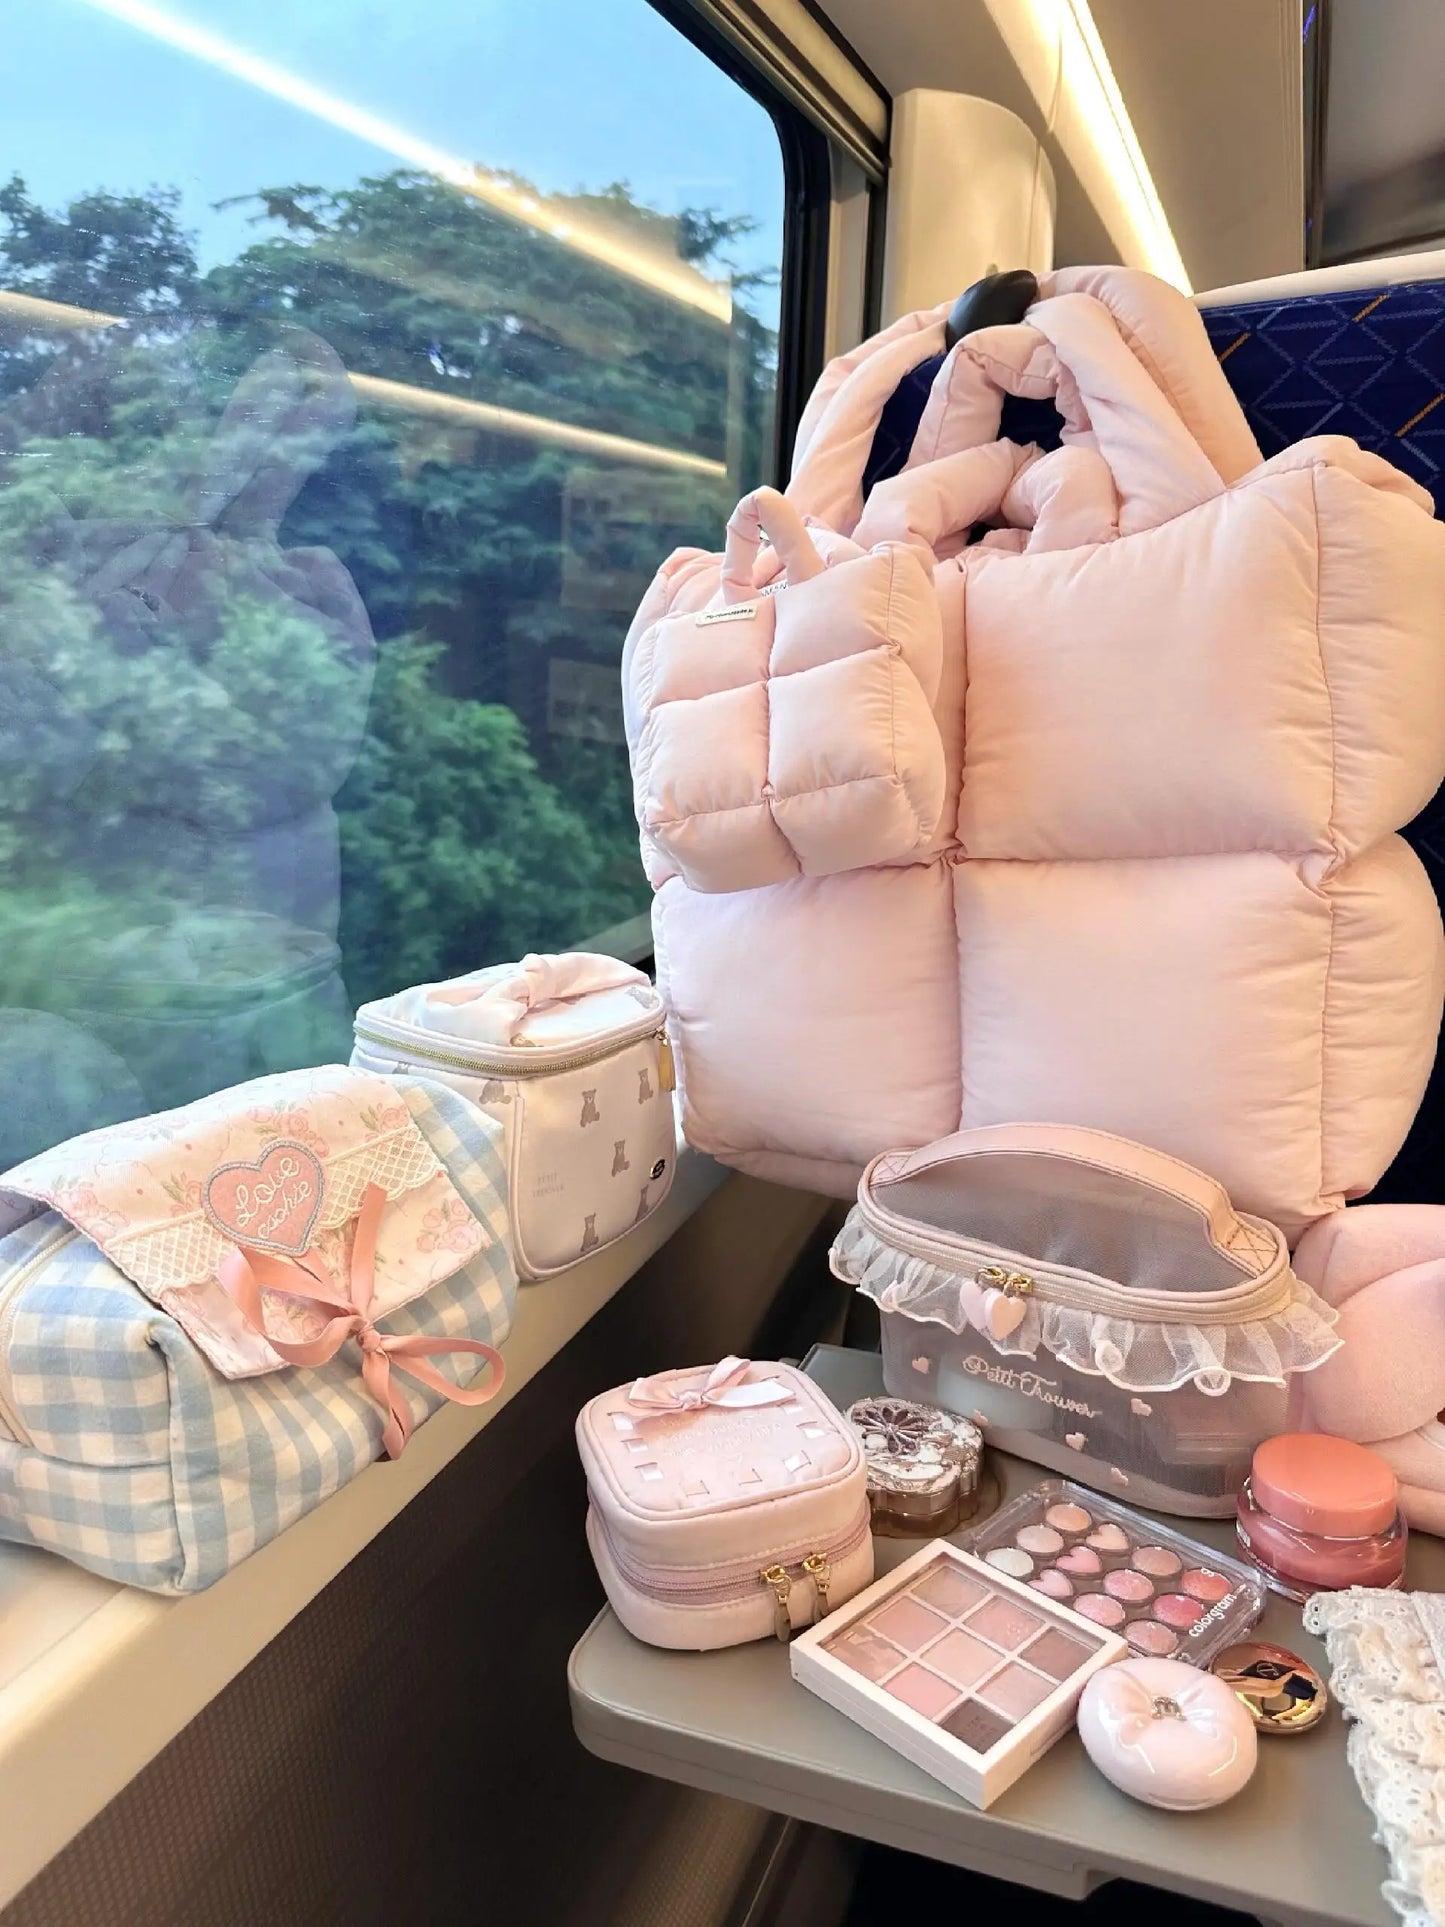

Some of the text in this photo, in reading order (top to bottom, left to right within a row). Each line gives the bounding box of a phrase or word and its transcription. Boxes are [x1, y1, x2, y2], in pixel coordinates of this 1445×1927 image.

[236, 1157, 299, 1227] Love
[257, 1181, 312, 1238] cookie
[1188, 1592, 1237, 1638] colorgram
